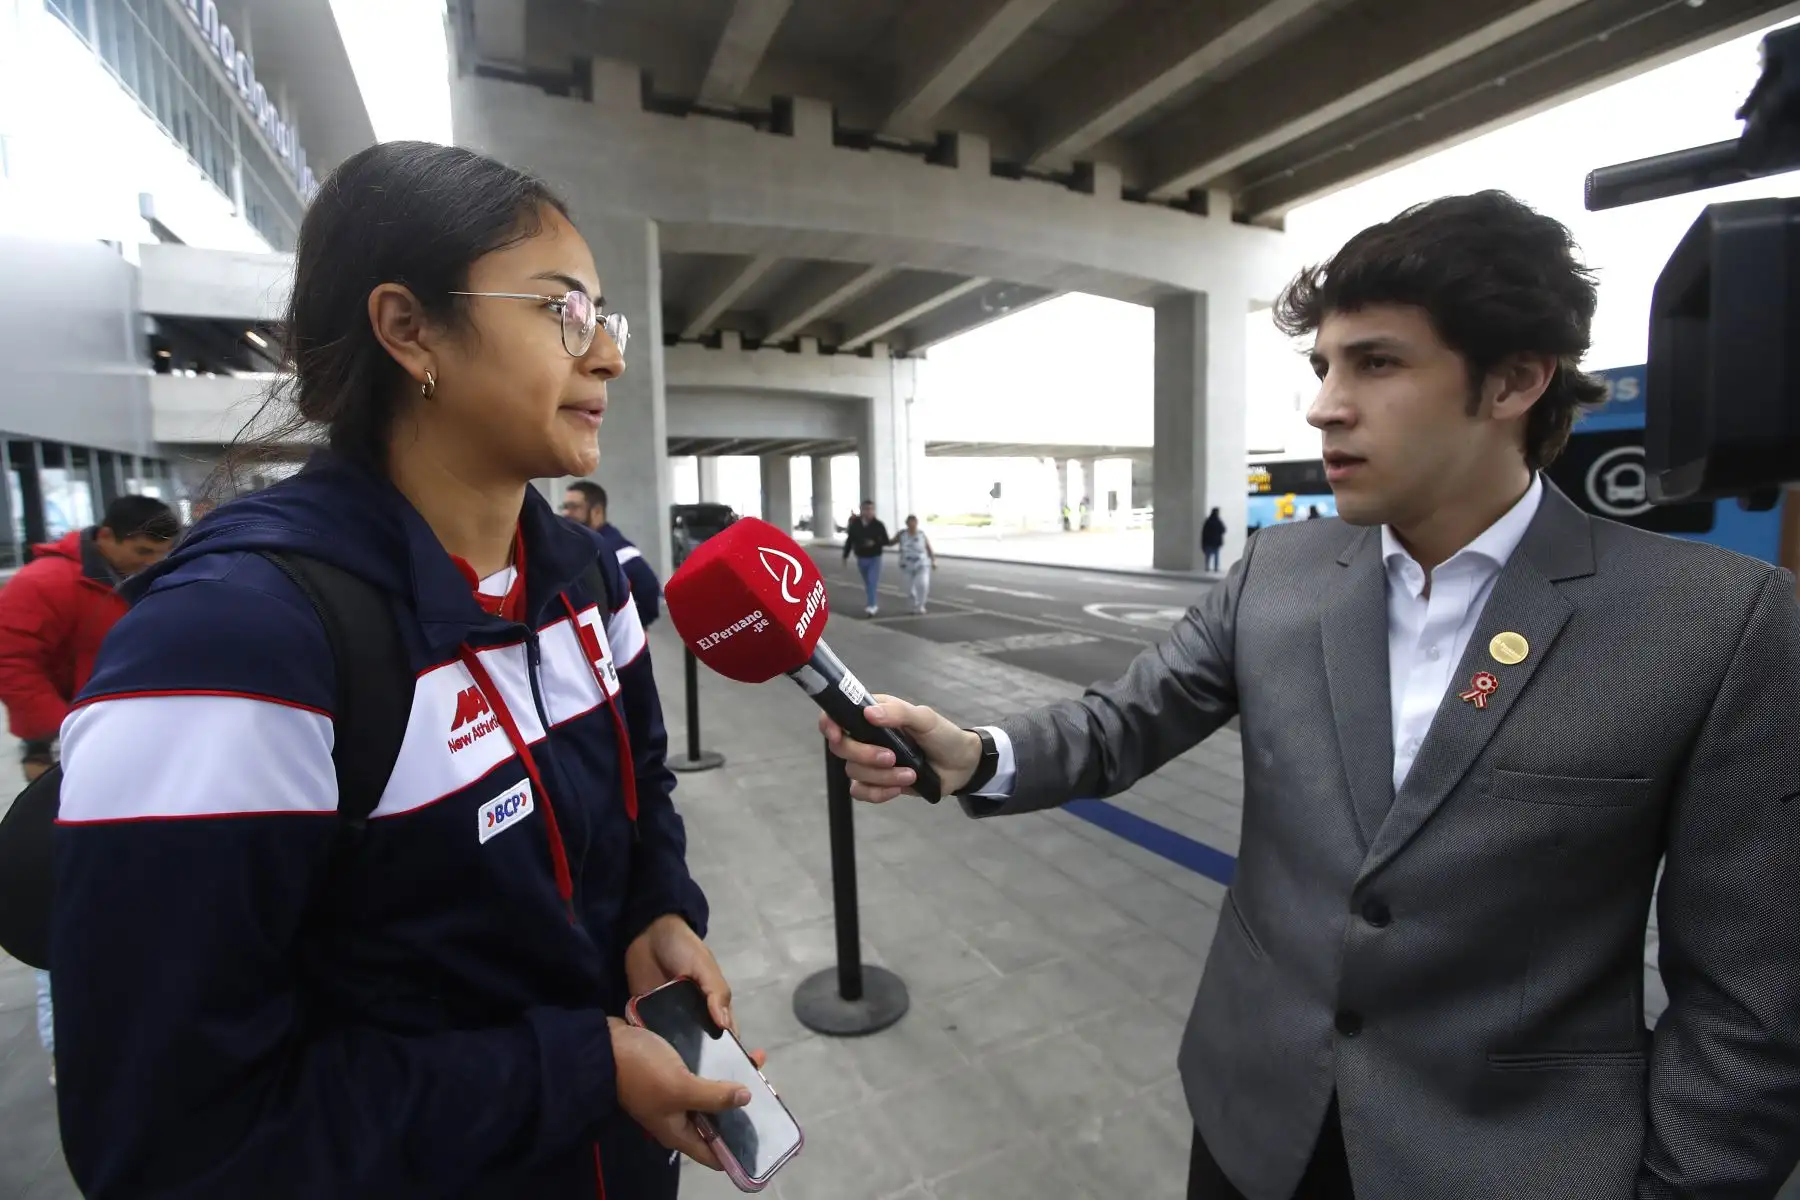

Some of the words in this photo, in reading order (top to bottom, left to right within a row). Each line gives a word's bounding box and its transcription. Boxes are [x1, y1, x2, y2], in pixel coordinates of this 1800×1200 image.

[795, 580, 824, 639] andina
[696, 637, 715, 651] El
[709, 610, 763, 644] Peruano
[752, 618, 770, 633] .pe
[447, 732, 472, 754] New
[495, 794, 521, 824] BCP
